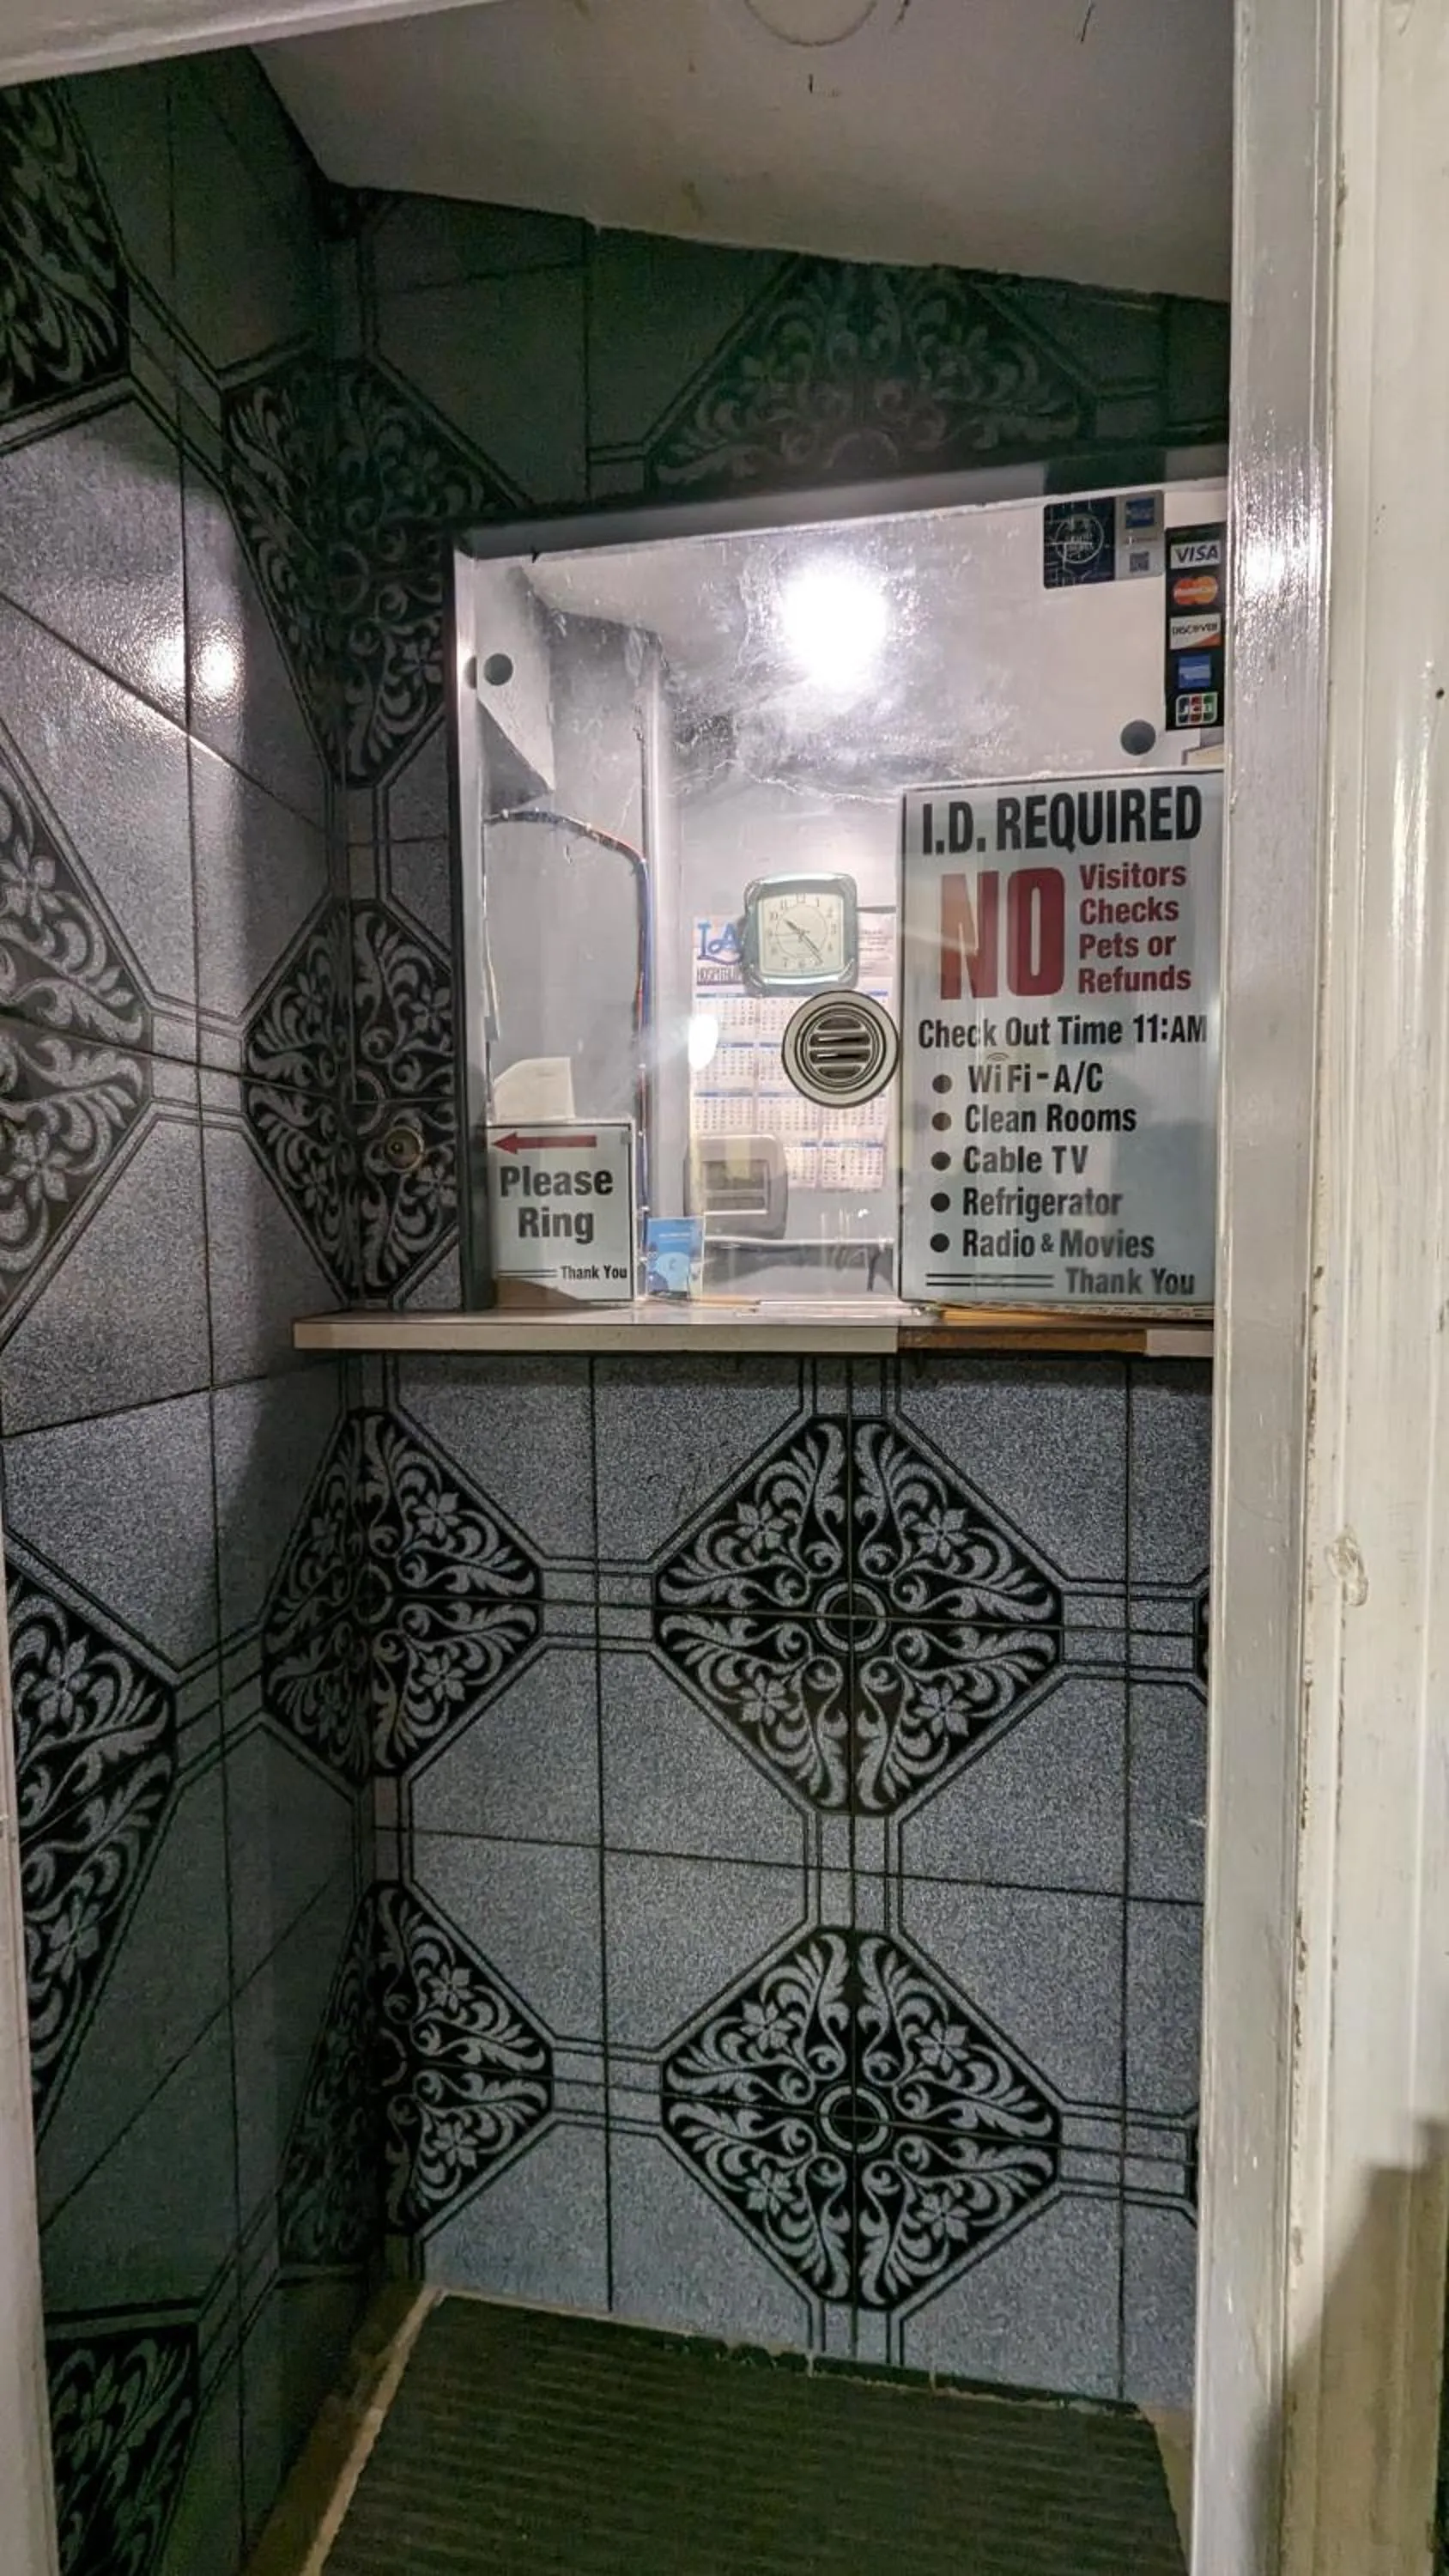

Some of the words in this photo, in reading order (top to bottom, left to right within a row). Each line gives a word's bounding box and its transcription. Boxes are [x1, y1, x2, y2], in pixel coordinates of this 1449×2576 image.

[1174, 544, 1218, 563] VISA
[923, 801, 986, 855] I.D.
[997, 785, 1202, 854] REQUIRED
[1078, 862, 1187, 890] Visitors
[1079, 897, 1179, 925] Checks
[941, 867, 1065, 1000] NO
[1078, 933, 1139, 960] Pets
[1149, 936, 1178, 957] or
[1078, 965, 1192, 994] Refunds
[919, 1018, 997, 1048] Check
[1005, 1017, 1051, 1046] Out
[1058, 1015, 1123, 1045] Time
[1133, 1014, 1208, 1044] 11:AM
[965, 1103, 1036, 1133] Clean
[1046, 1103, 1137, 1133] Rooms
[963, 1145, 1043, 1175] Cable
[1052, 1145, 1089, 1175] TV
[500, 1164, 615, 1198] Please
[962, 1187, 1124, 1223] Refrigerator
[518, 1206, 594, 1244] Ring
[962, 1229, 1036, 1258] Radio
[1040, 1233, 1054, 1253] &
[1059, 1228, 1155, 1259] Movies
[561, 1265, 600, 1279] Thank
[603, 1265, 627, 1279] You
[1065, 1266, 1143, 1295] Thank
[1149, 1268, 1196, 1296] You
